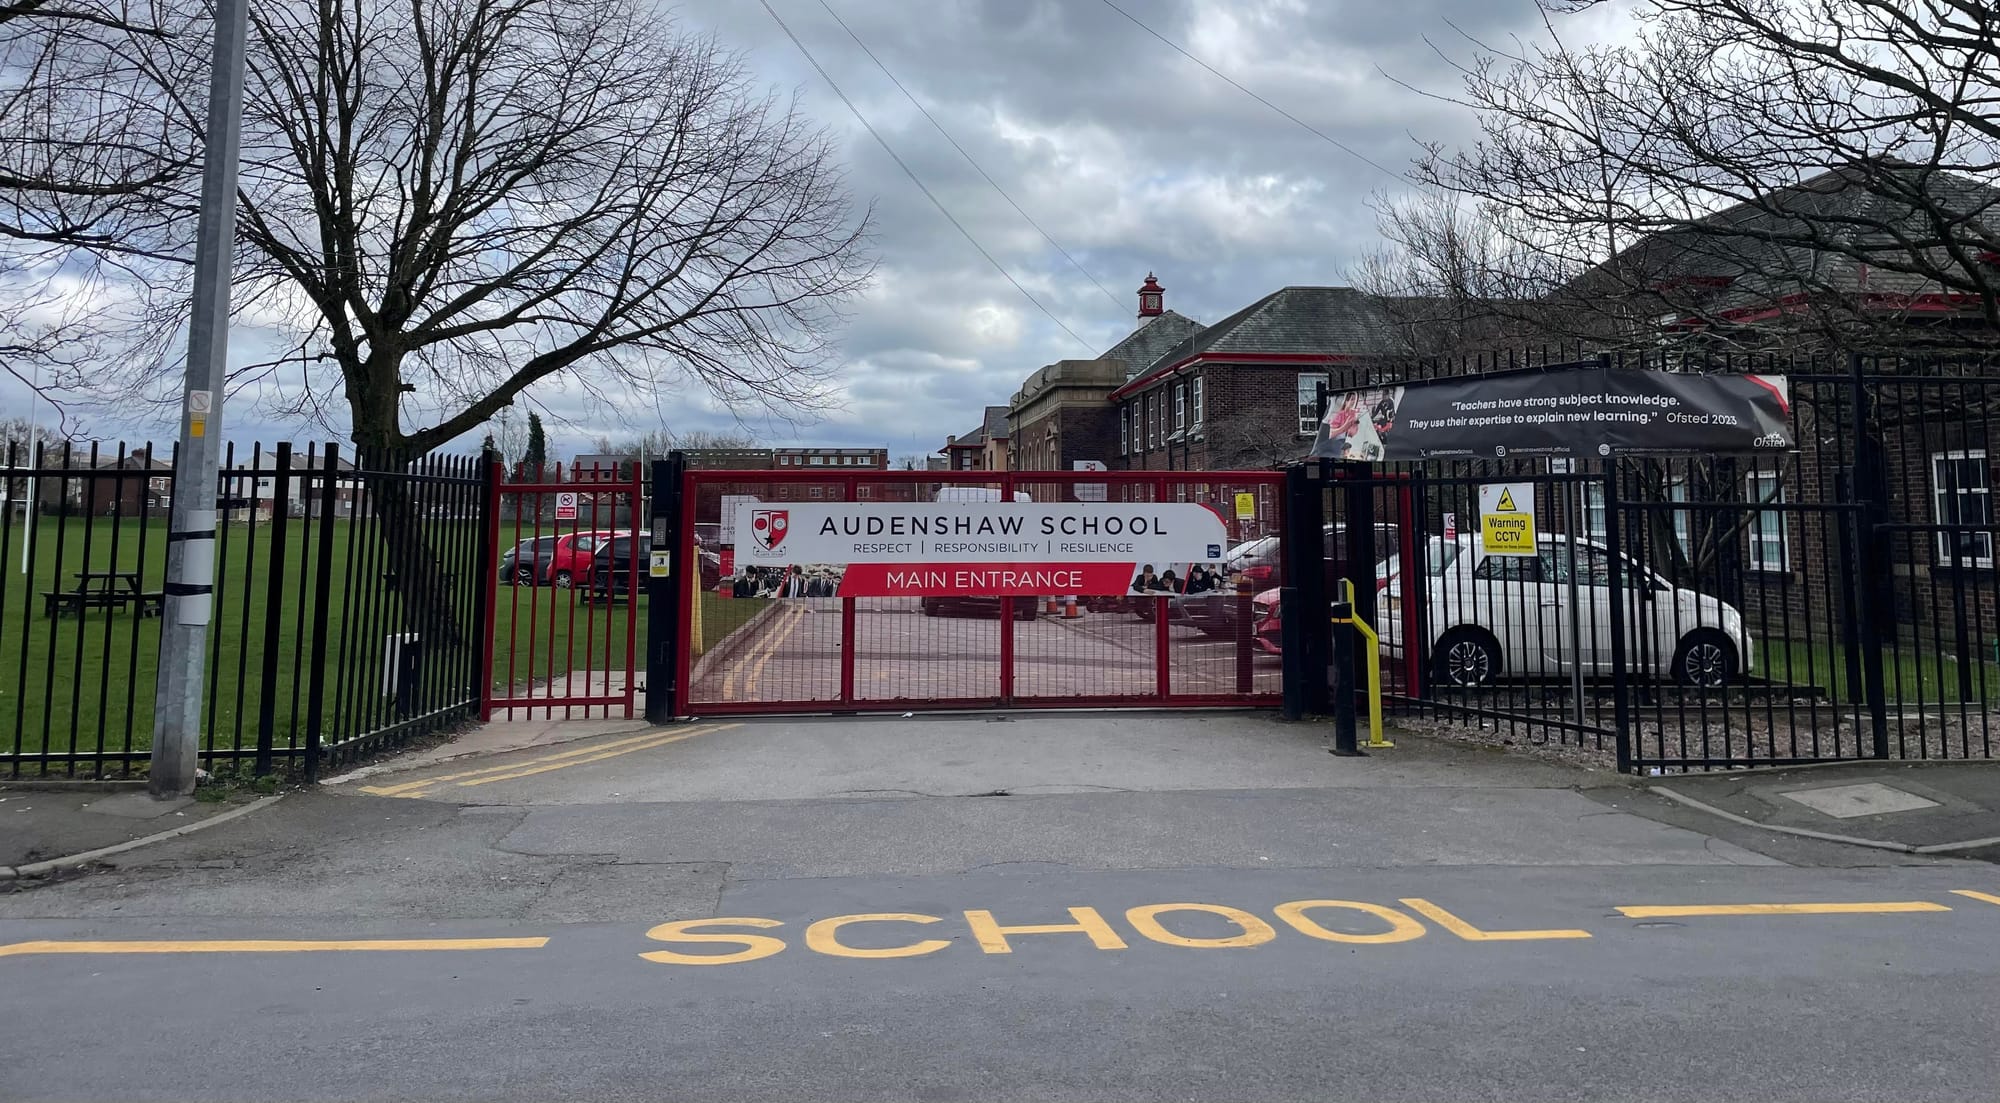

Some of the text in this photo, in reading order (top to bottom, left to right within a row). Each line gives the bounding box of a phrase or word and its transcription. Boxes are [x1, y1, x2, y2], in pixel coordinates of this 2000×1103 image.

[1452, 393, 1680, 411] “Teachers have strong subject knowledge.
[1409, 410, 1738, 430] They use their expertise to explain new learning.” Ofsted 2023
[819, 516, 1168, 535] AUDENSHAW SCHOOL
[1488, 517, 1526, 531] Warning
[1495, 531, 1521, 542] CCTV
[853, 543, 1134, 553] RESPECT RESPONSIBILITY RESILIENCE
[887, 571, 1083, 588] MAIN ENTRANCE
[637, 897, 1593, 966] SCHOOL
